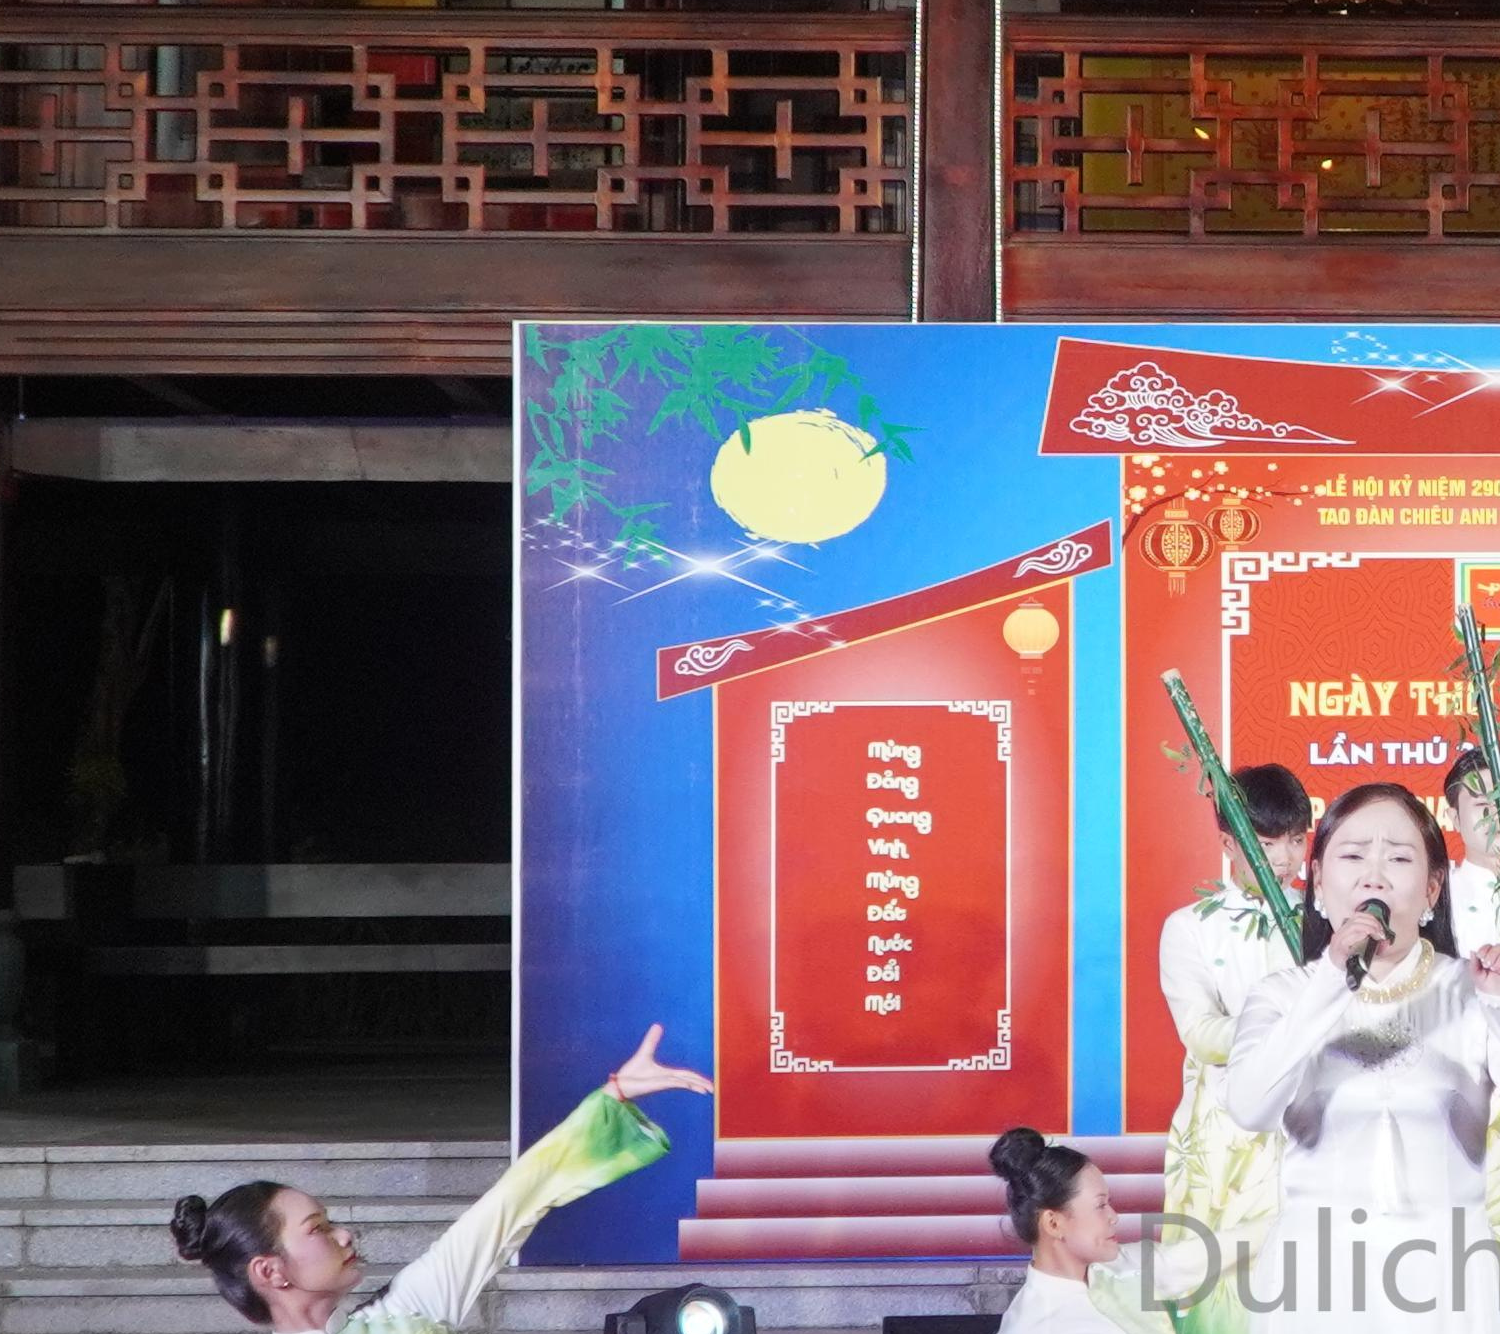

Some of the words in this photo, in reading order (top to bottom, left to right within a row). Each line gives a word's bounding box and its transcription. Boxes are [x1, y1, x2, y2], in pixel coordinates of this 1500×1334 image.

[1325, 473, 1348, 497] LỄ
[1352, 476, 1384, 500] HỘI
[1388, 474, 1413, 497] KỶ
[1417, 476, 1466, 501] NIỆM
[1317, 507, 1350, 525] TAO
[1355, 504, 1394, 525] ĐÀN
[1399, 504, 1454, 525] CHIÊU
[1459, 507, 1498, 525] ANH
[1289, 673, 1399, 717] NGÀY
[1309, 732, 1374, 765] LẦN
[866, 770, 919, 800] Đảng
[866, 808, 932, 835] Quang
[867, 838, 910, 859] Vinh
[866, 898, 907, 921] Đất
[866, 958, 900, 982] Đổi
